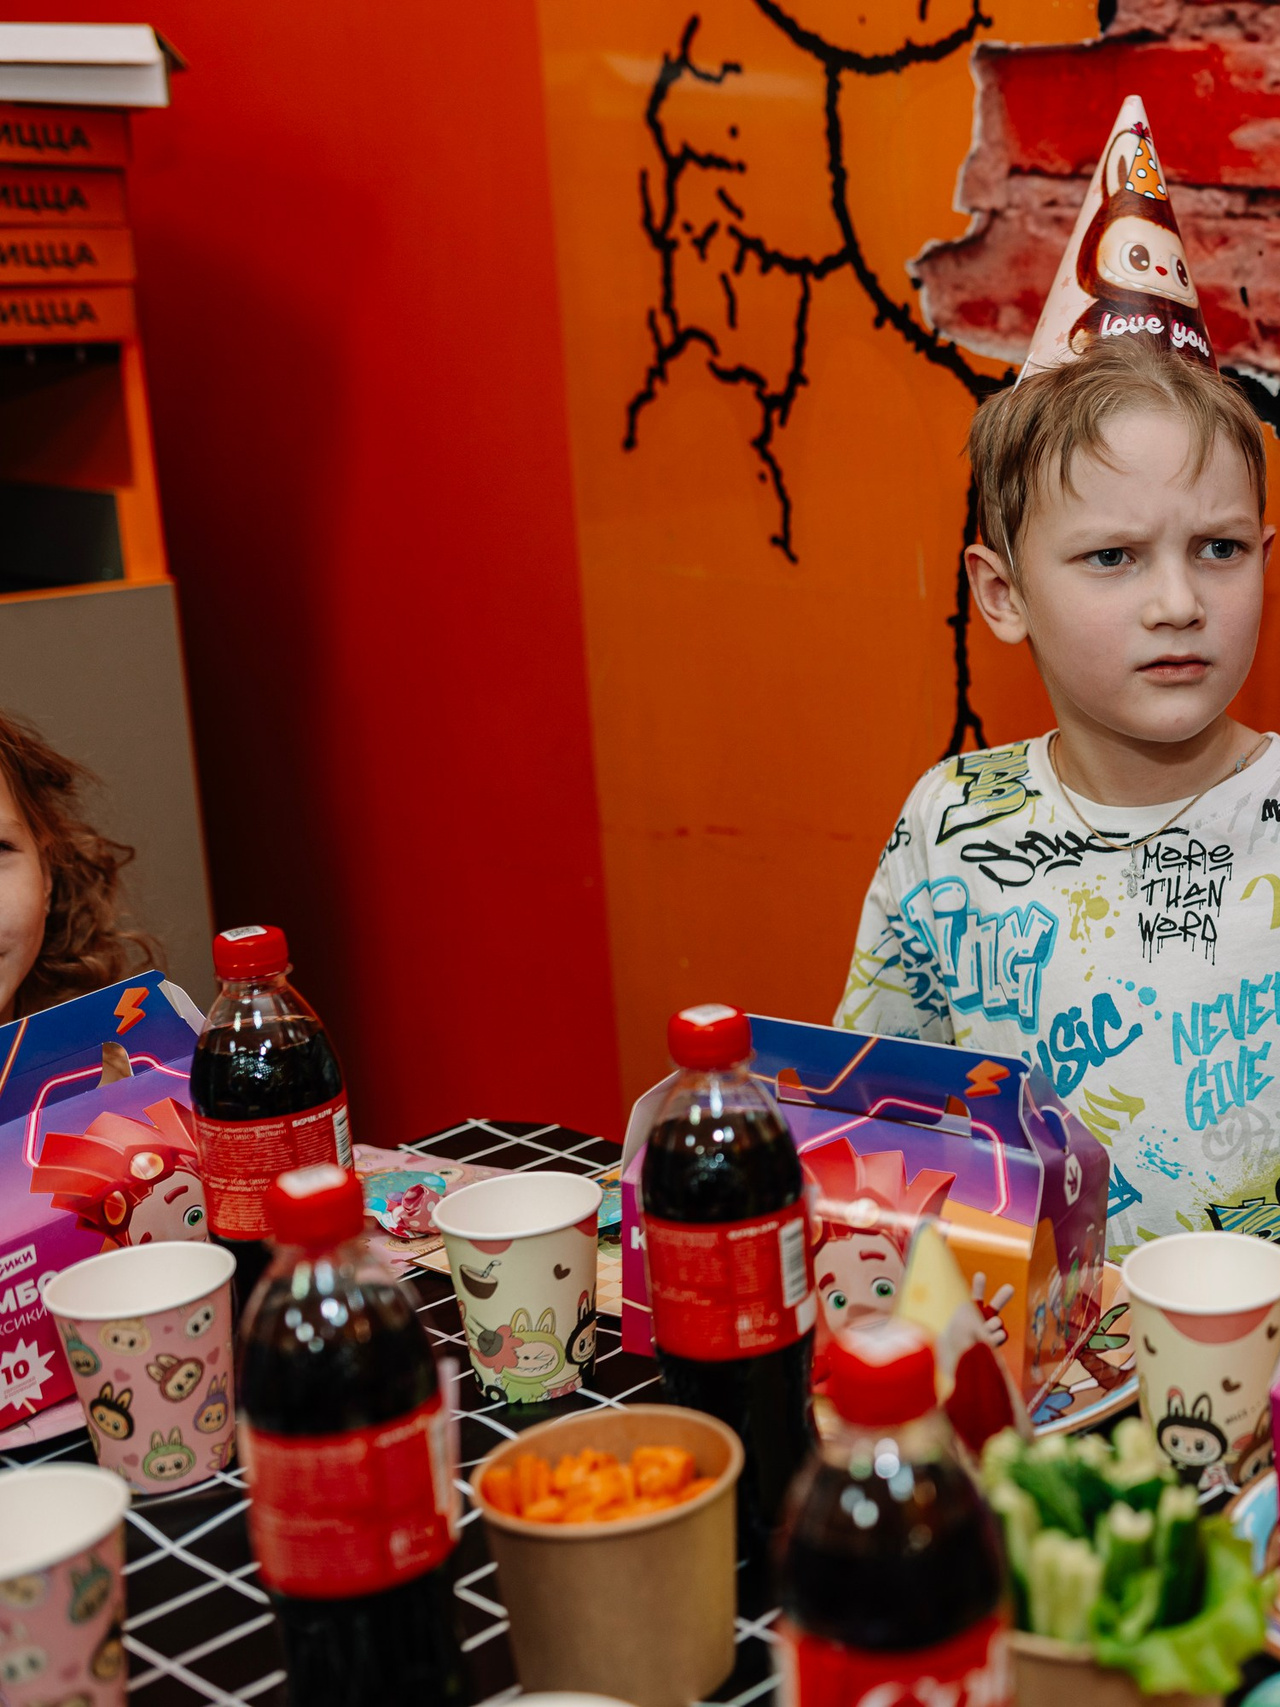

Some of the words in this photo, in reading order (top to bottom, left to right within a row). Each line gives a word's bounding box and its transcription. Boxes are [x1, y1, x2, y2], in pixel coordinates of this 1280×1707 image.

[1169, 319, 1210, 357] you
[1141, 875, 1226, 915] THAN
[1185, 1042, 1275, 1131] GIVE
[1, 1359, 30, 1385] 10
